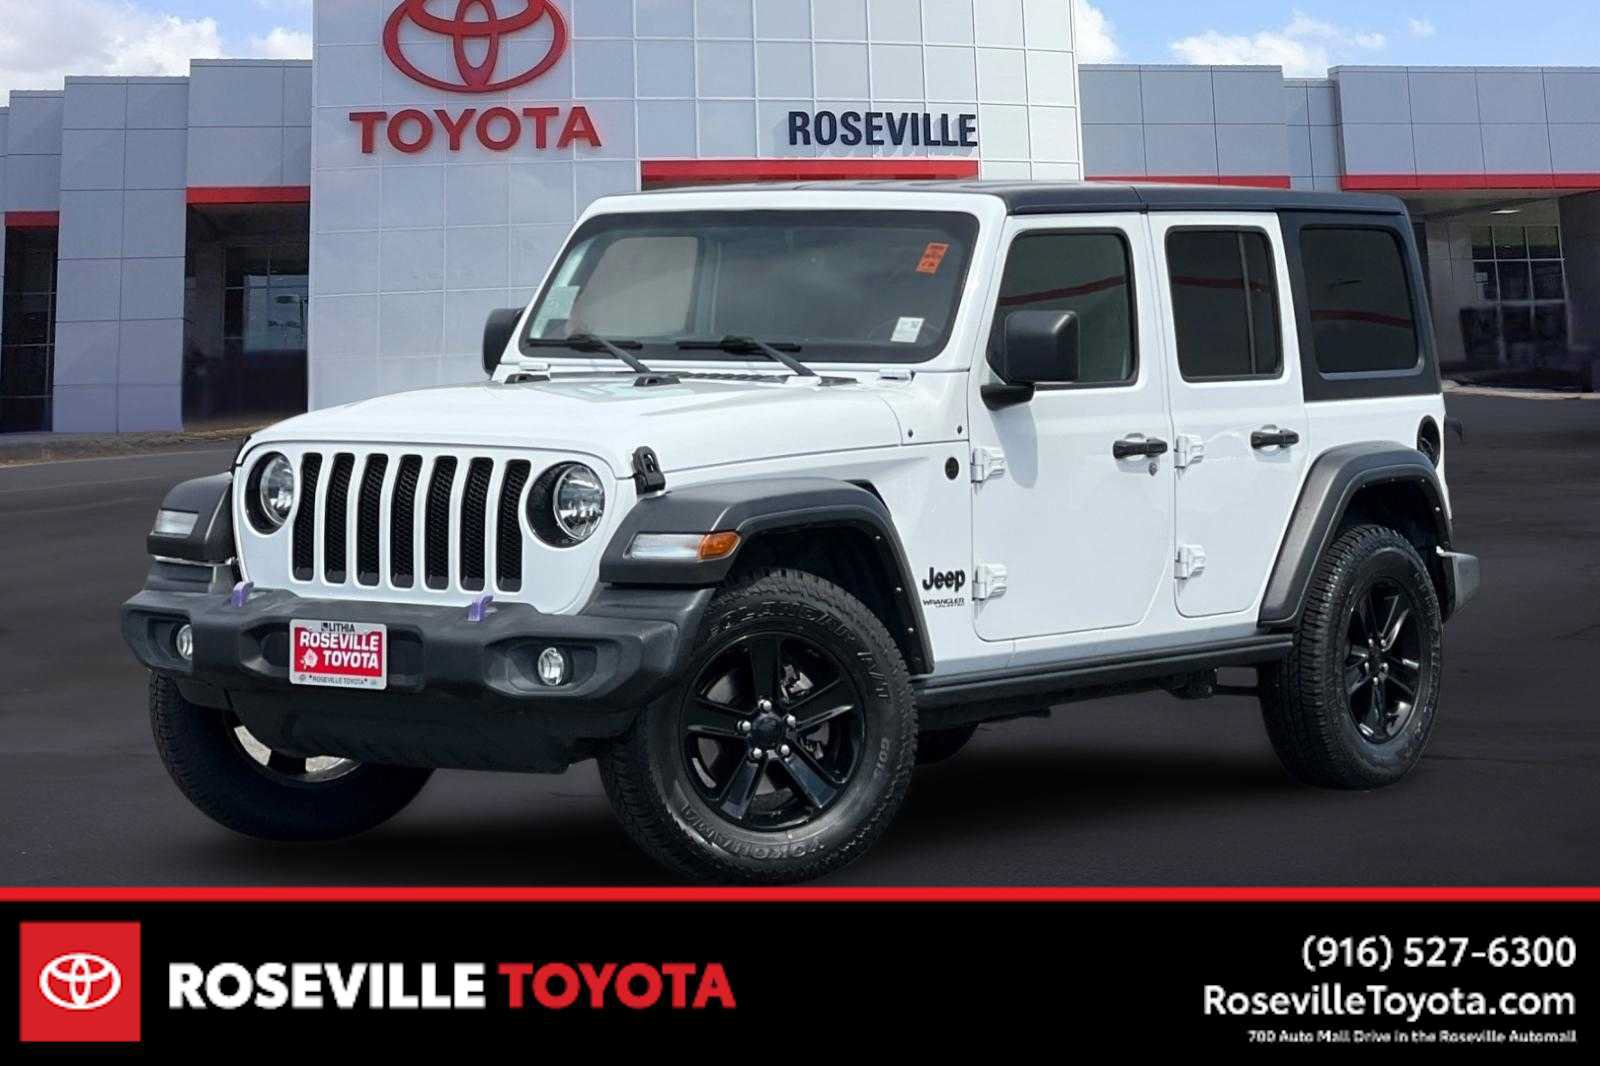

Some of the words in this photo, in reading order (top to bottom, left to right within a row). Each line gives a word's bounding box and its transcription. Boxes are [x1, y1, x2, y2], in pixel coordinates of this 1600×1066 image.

[349, 106, 602, 154] TOYOTA
[788, 110, 979, 147] ROSEVILLE
[922, 566, 966, 592] Jeep
[329, 623, 355, 632] LITHIA
[300, 632, 379, 651] ROSEVILLE
[324, 650, 379, 669] TOYOTA
